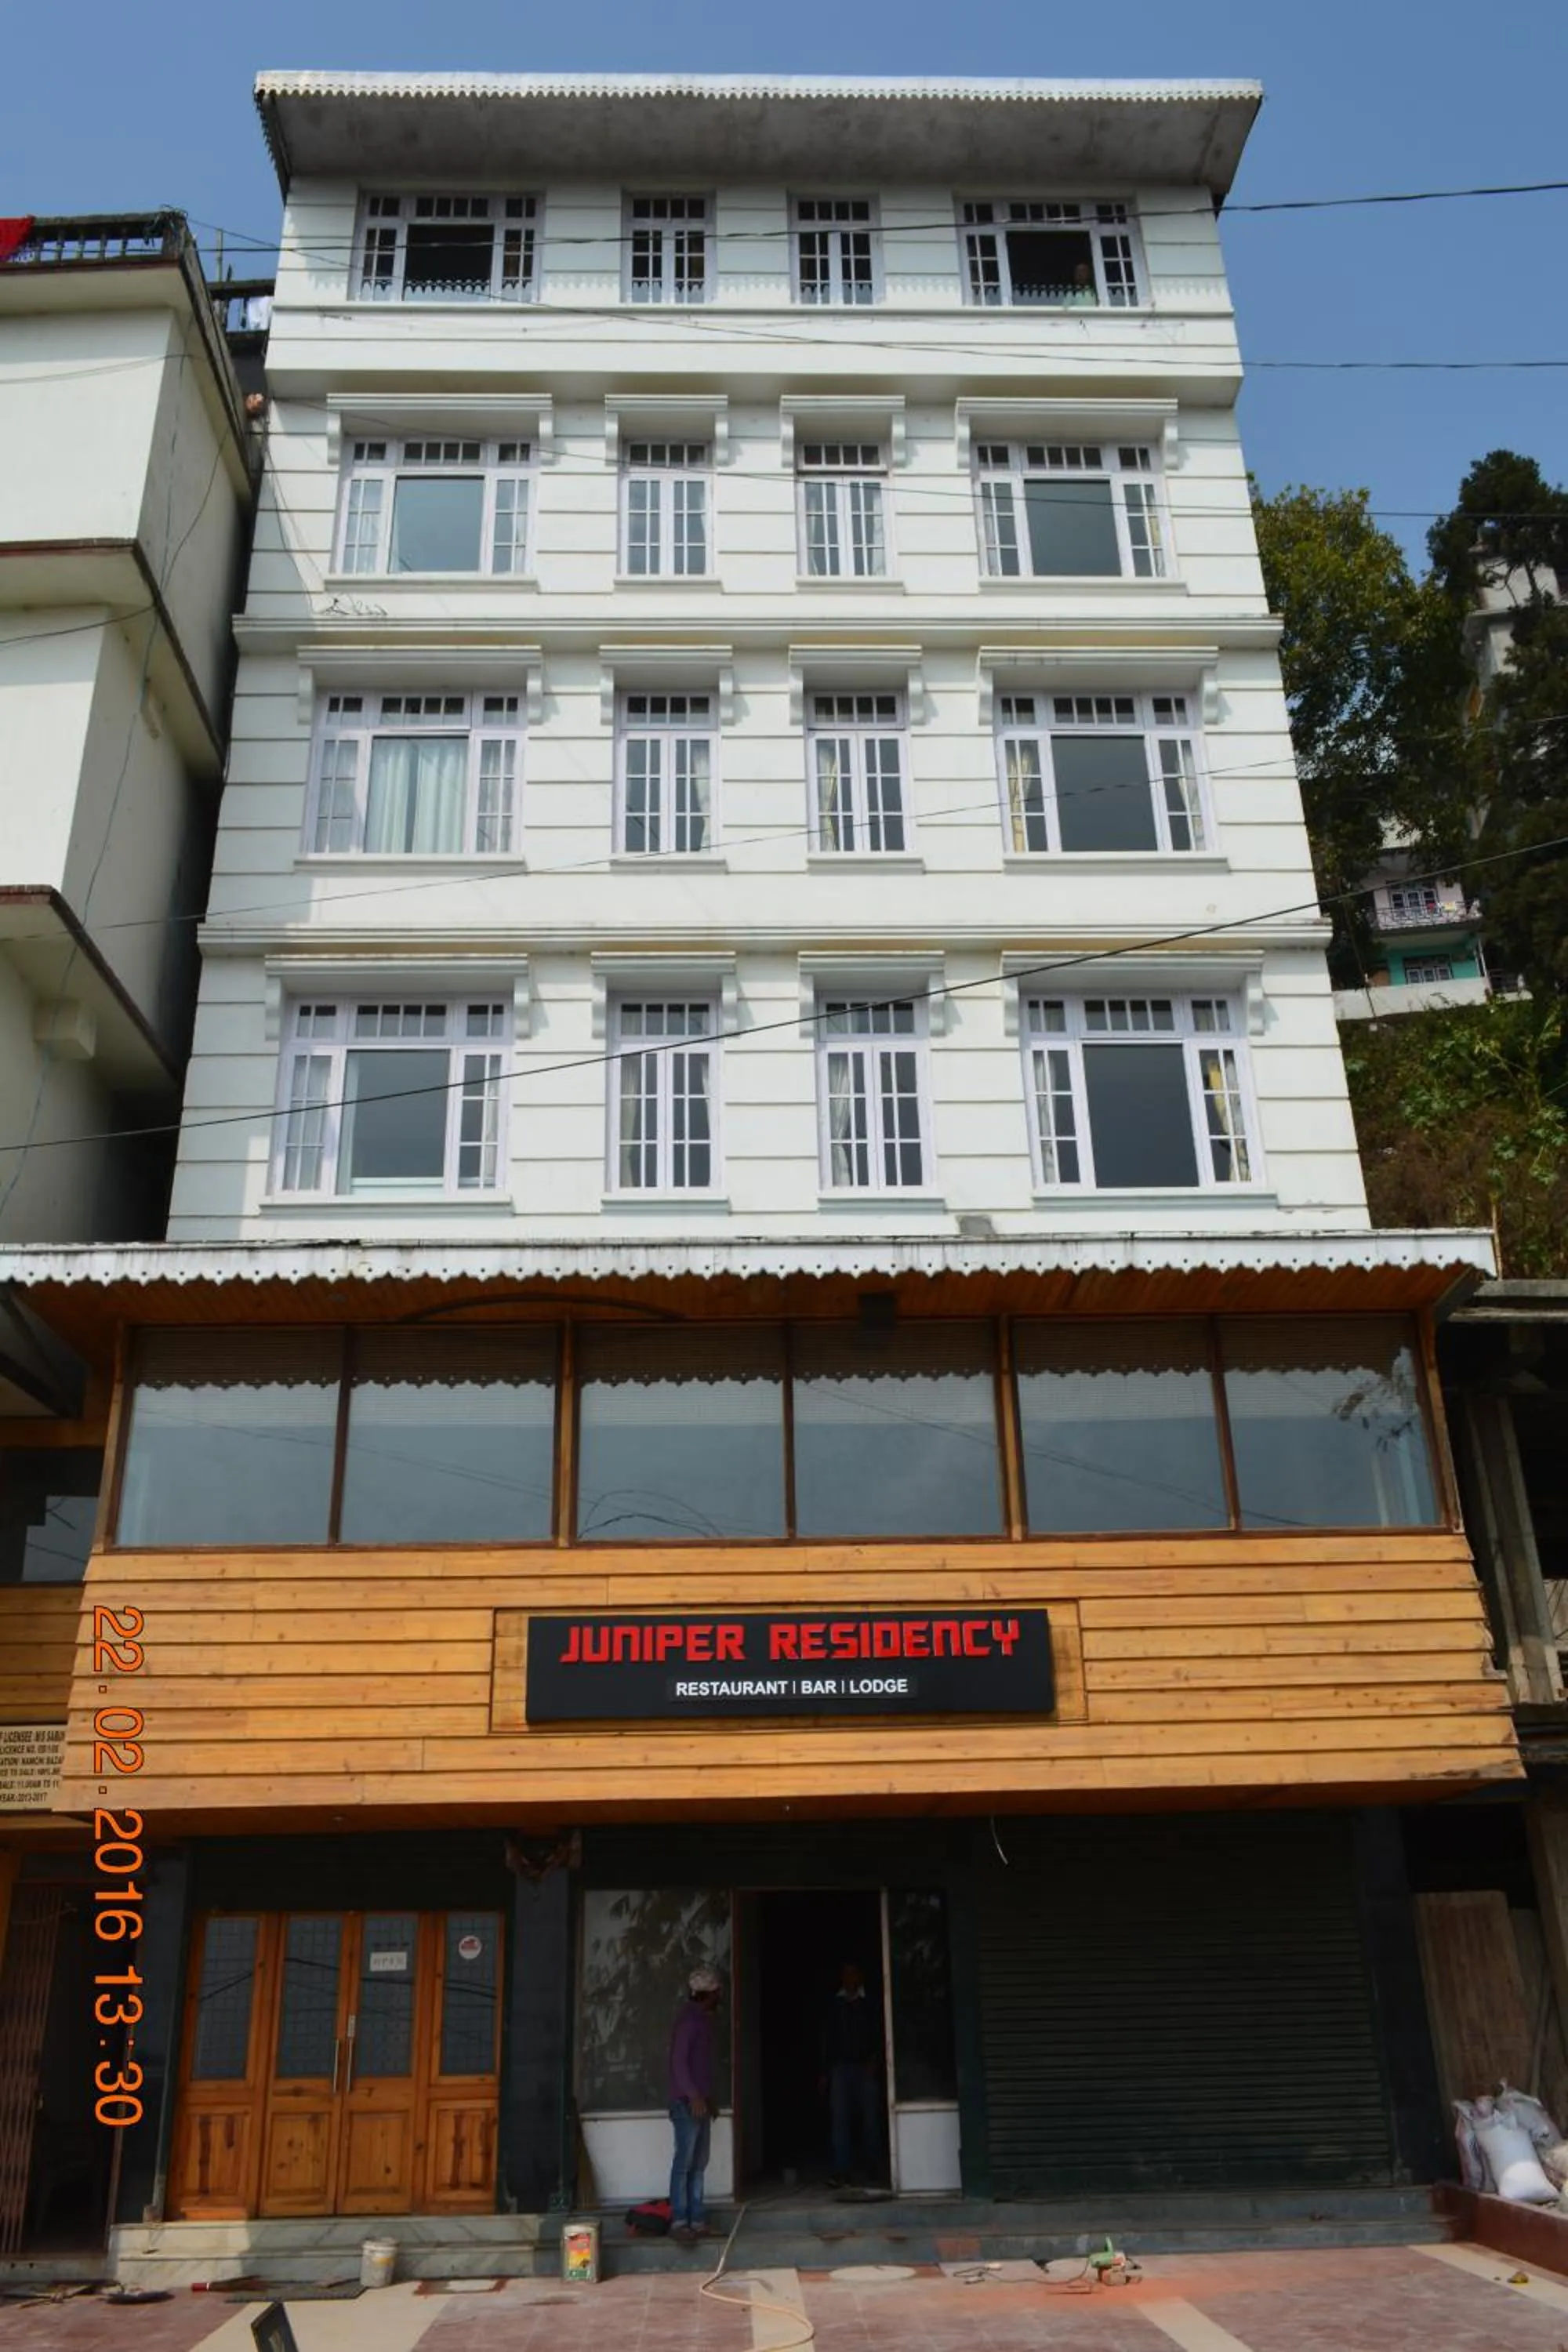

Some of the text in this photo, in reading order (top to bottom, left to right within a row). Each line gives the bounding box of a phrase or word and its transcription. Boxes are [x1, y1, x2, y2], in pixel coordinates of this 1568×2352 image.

[561, 1620, 1019, 1662] JUNIPER RESIDENCY
[676, 1679, 909, 1697] RESTAURANT BAR LODGE
